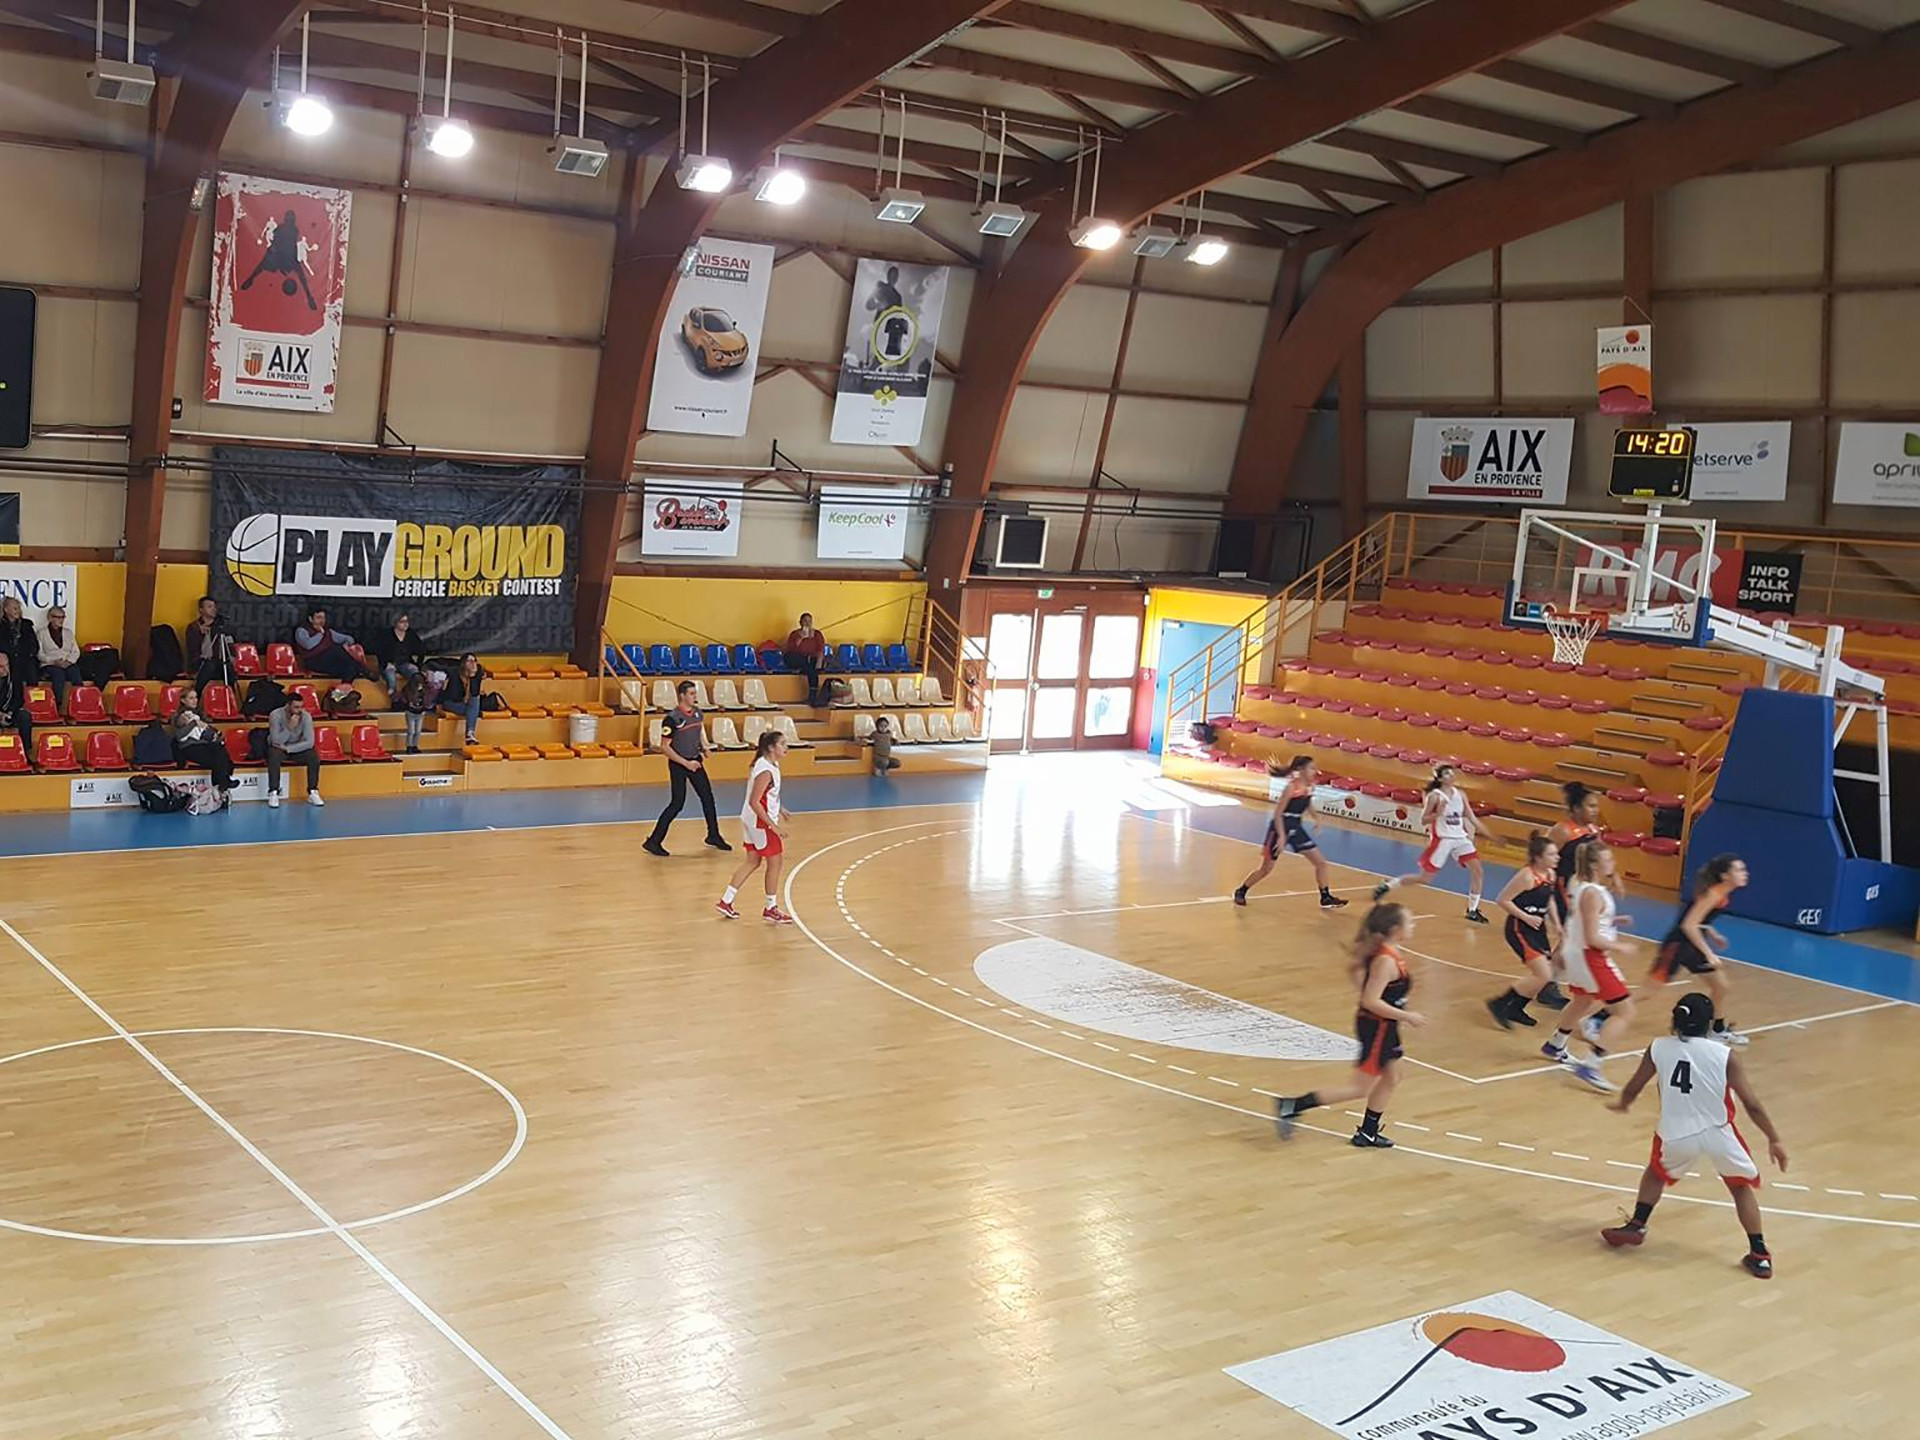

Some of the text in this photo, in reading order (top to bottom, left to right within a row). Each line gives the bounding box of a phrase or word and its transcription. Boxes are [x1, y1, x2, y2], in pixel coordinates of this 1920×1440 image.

[697, 253, 751, 270] NISSAN
[697, 267, 747, 280] COURIANT
[268, 345, 310, 374] AIX
[277, 373, 308, 382] PROVENCE
[1476, 430, 1546, 472] AIX
[1627, 433, 1685, 455] 14:20
[1474, 473, 1542, 486] EN PROVENCE
[1751, 565, 1789, 578] INFO
[394, 579, 562, 598] CERCLE BASKET CONTEST
[1748, 578, 1789, 591] TALK
[1738, 589, 1794, 604] SPORT
[1322, 806, 1339, 815] PAYS
[1372, 816, 1390, 826] PAYS
[1797, 908, 1822, 925] GES
[1670, 1060, 1693, 1094] 4
[1526, 1356, 1694, 1420] D'AIX
[1357, 1395, 1488, 1440] communauté du
